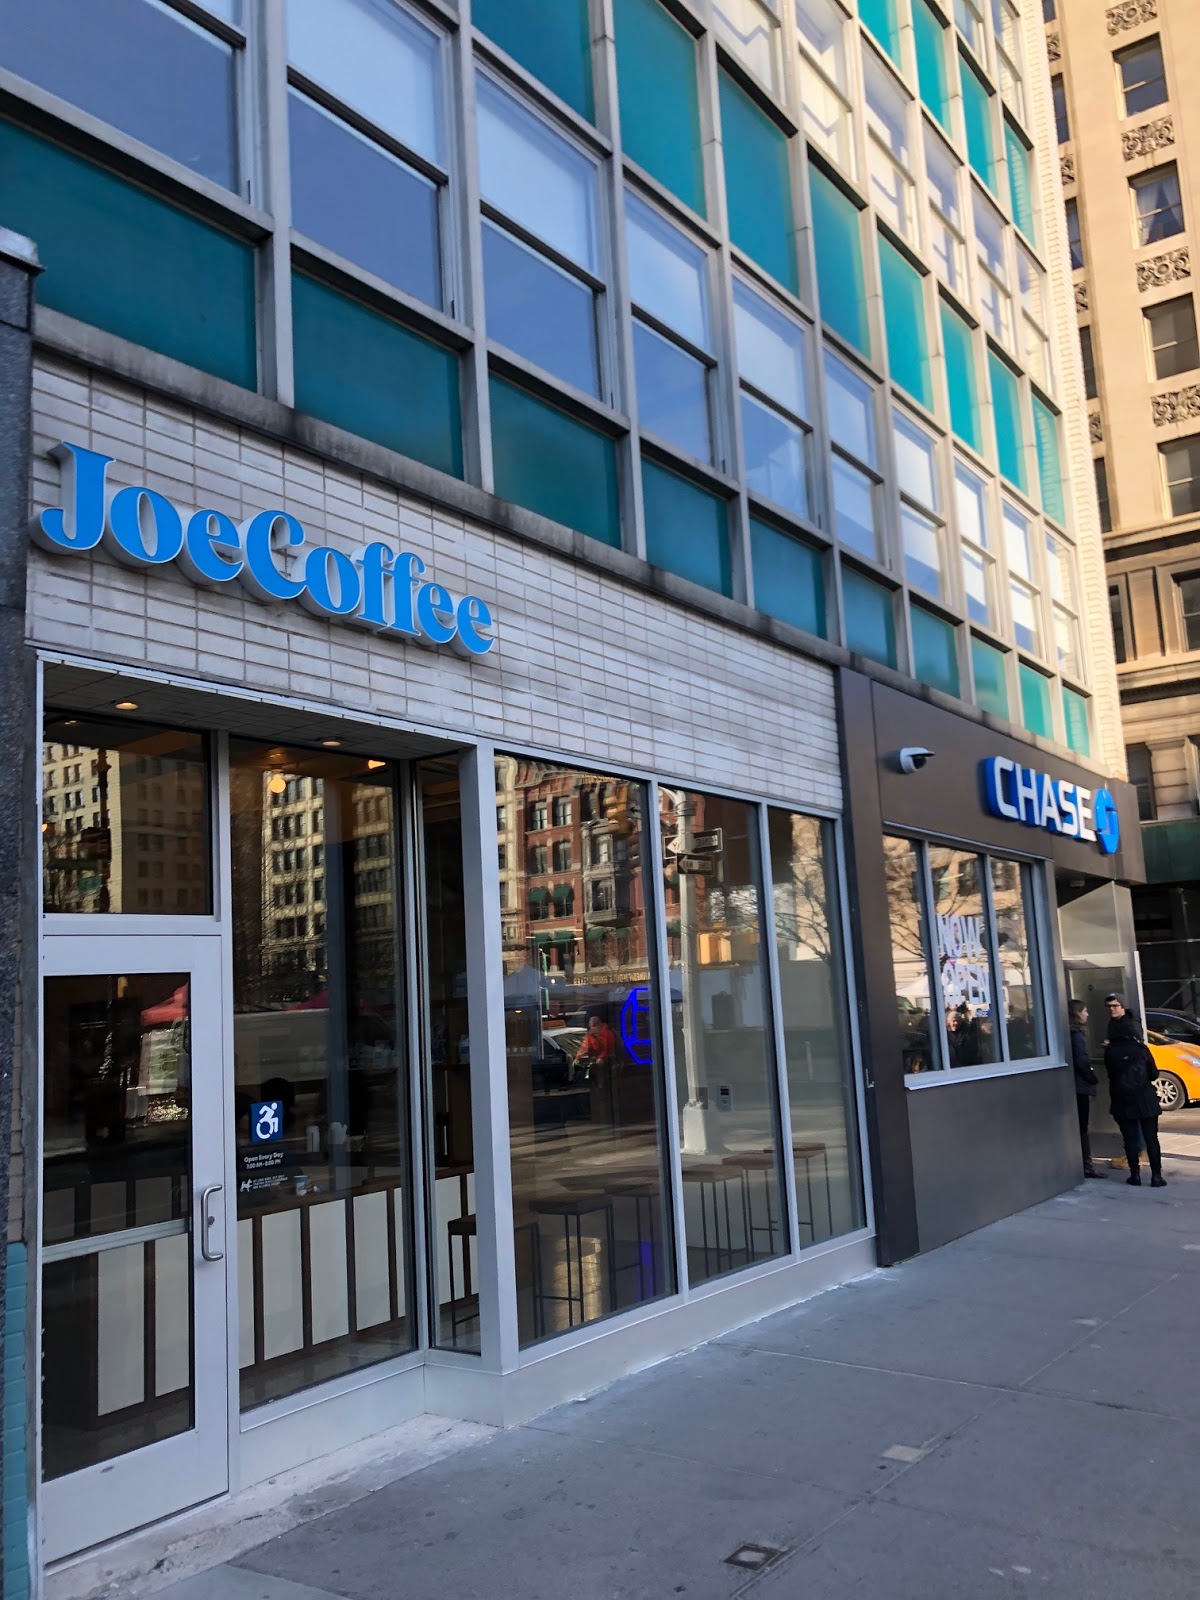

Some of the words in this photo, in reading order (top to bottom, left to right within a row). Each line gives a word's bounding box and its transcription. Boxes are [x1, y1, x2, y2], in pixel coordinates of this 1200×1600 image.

[991, 755, 1098, 842] CHASE
[936, 913, 981, 958] NOW
[941, 962, 992, 1005] OPEN
